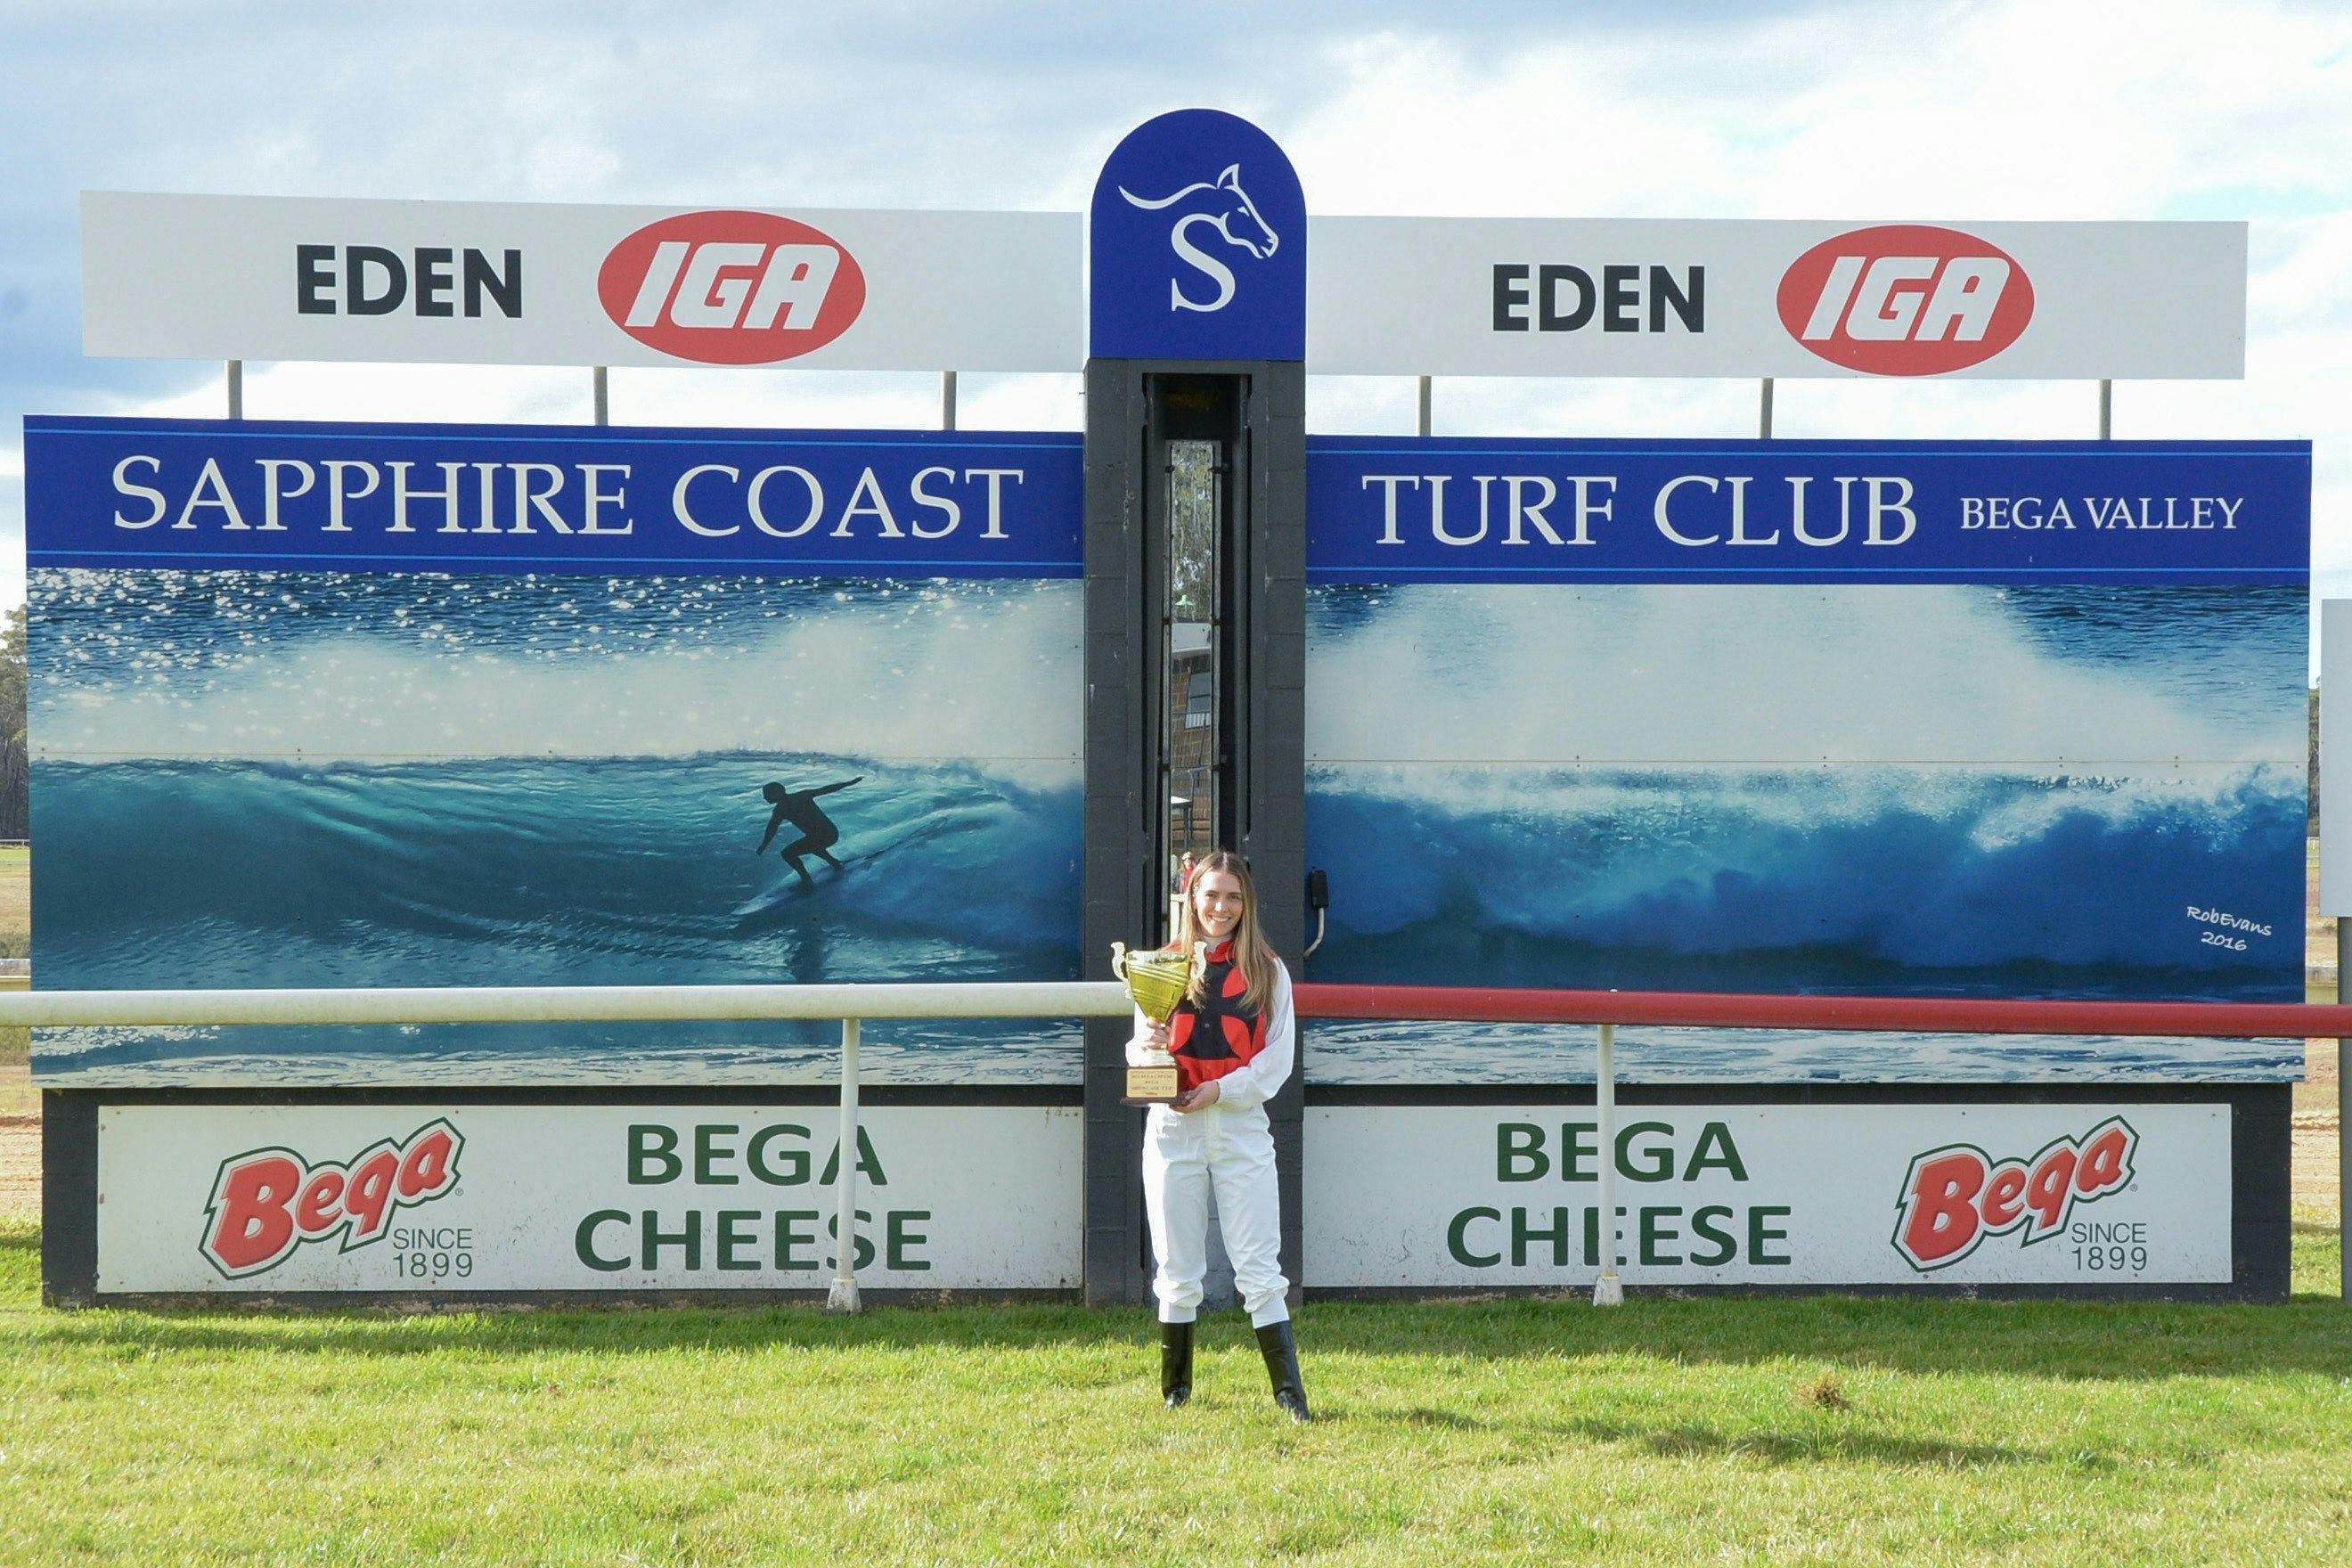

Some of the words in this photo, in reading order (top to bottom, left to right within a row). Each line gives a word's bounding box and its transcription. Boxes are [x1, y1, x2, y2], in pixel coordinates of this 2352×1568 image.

[297, 244, 522, 319] EDEN
[625, 241, 840, 330] IGA
[1492, 264, 1705, 333] EDEN
[1801, 256, 2011, 341] IGA
[112, 455, 633, 535] SAPPHIRE
[672, 464, 1024, 540] COAST
[1361, 475, 1618, 546] TURF
[1654, 475, 1917, 547] CLUB
[1960, 497, 2076, 529] BEGA
[2083, 497, 2243, 529] VALLEY
[2201, 931, 2248, 951] 2016
[627, 1123, 888, 1186] BEGA
[1497, 1121, 1750, 1183] BEGA
[211, 1129, 453, 1270] Bega
[1903, 1126, 2127, 1262] Bega
[393, 1229, 473, 1249] SINCE
[575, 1209, 932, 1272] CHEESE
[1447, 1205, 1792, 1268] CHEESE
[2071, 1222, 2147, 1244] SINCE
[2071, 1245, 2148, 1270] 1899
[393, 1252, 473, 1278] 1899
